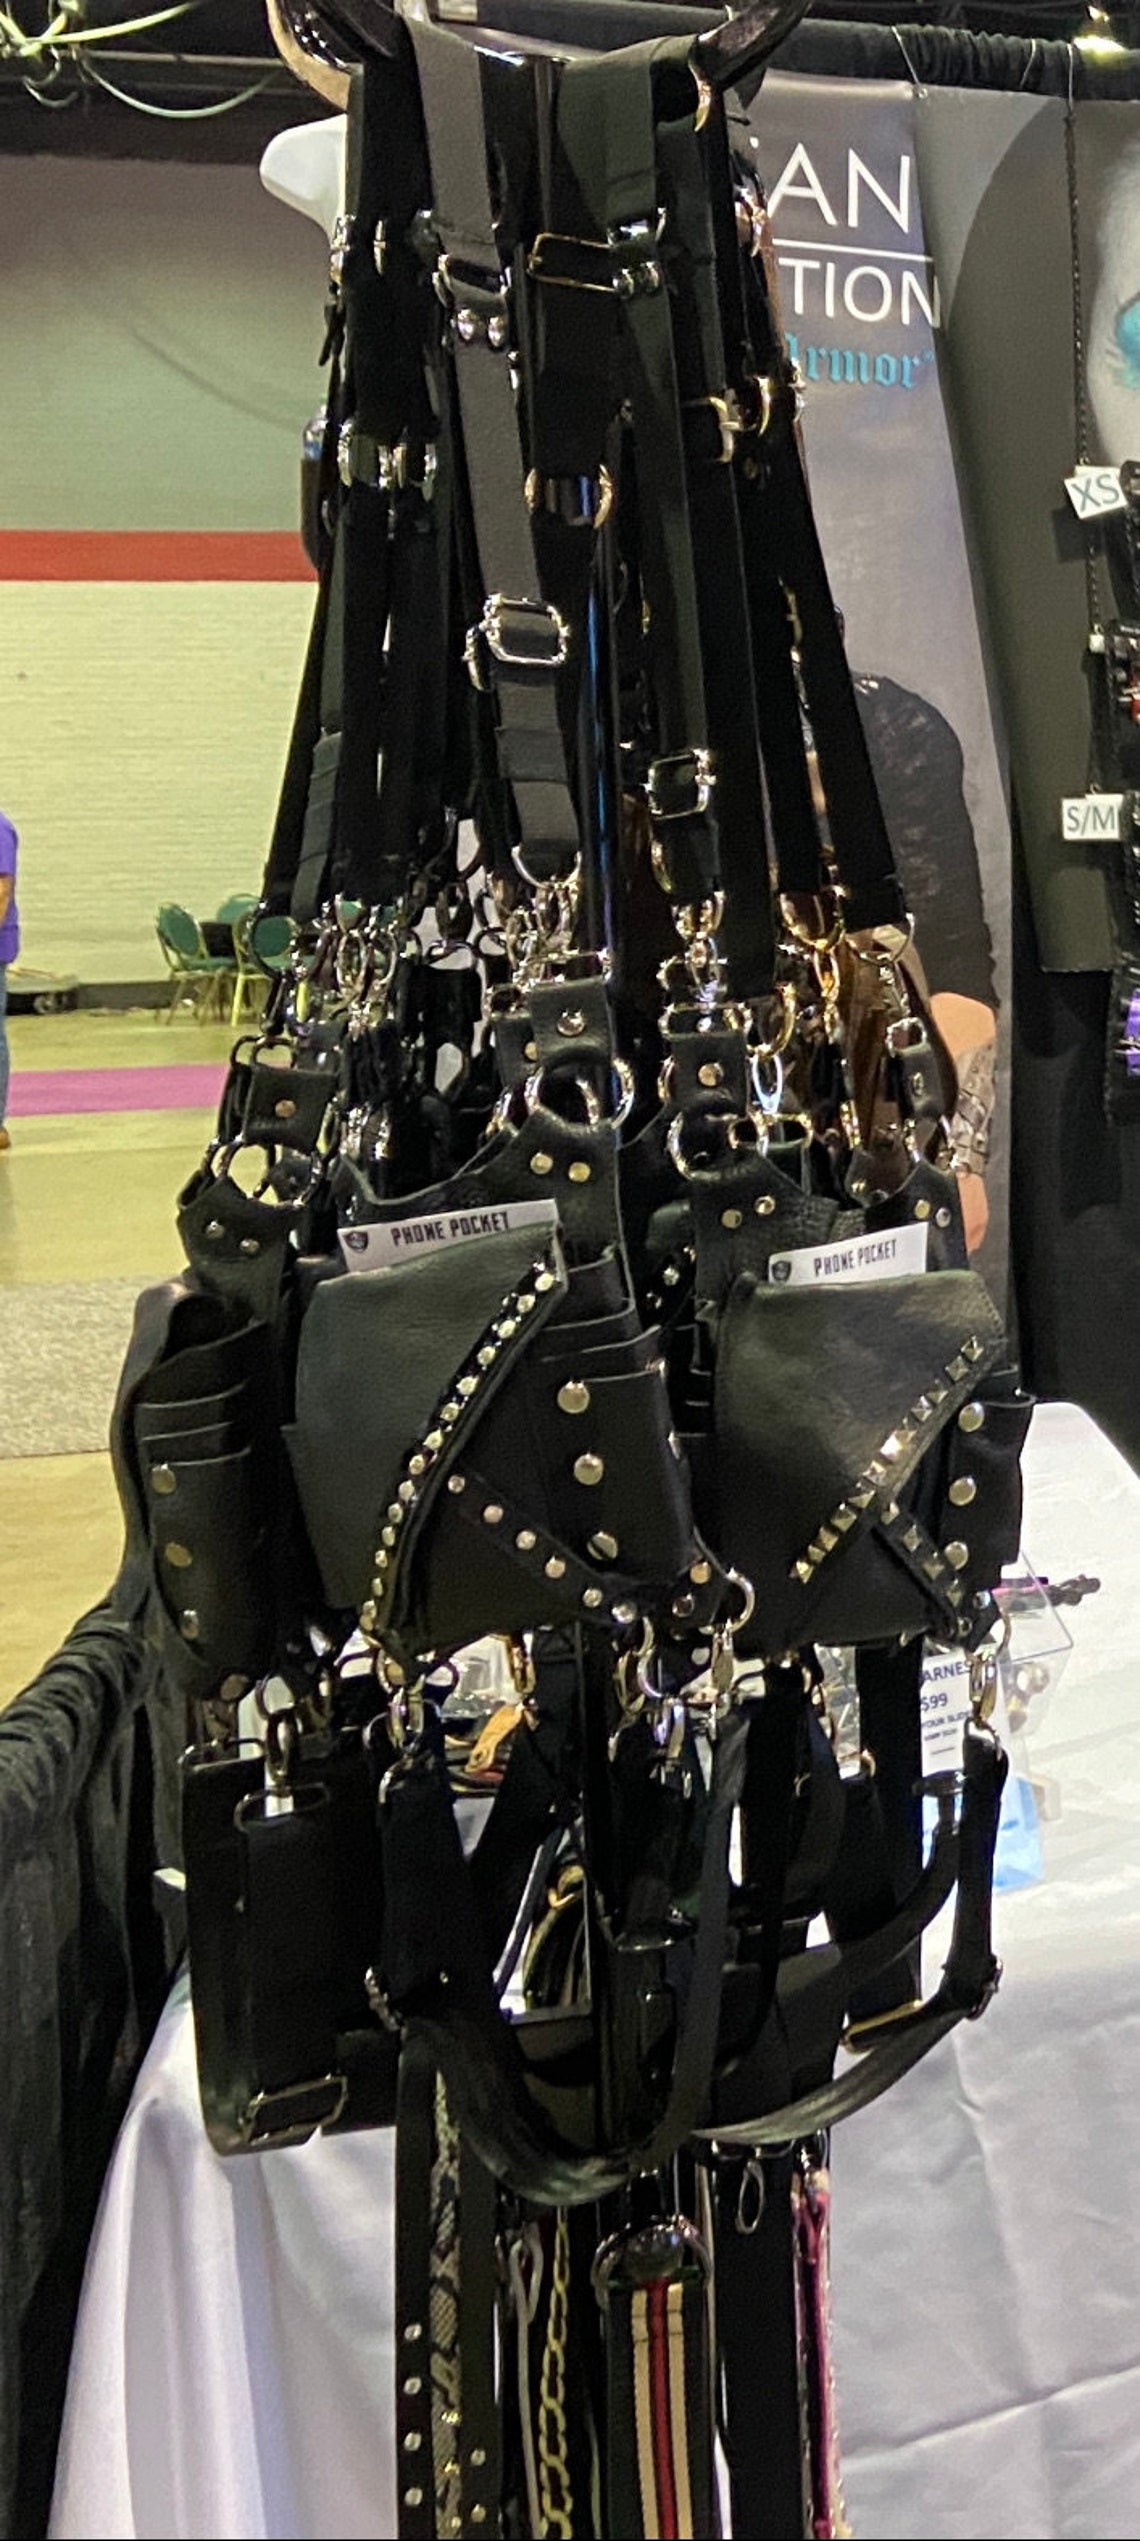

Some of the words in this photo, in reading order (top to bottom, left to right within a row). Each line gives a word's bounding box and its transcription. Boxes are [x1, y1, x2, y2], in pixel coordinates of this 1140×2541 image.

[778, 257, 941, 329] TION
[1071, 473, 1120, 512] XS
[1067, 805, 1115, 836] S/M
[391, 1221, 445, 1247] PHONE
[450, 1211, 510, 1238] POCKET
[814, 1250, 854, 1277] PHONE
[857, 1239, 897, 1266] POCKET
